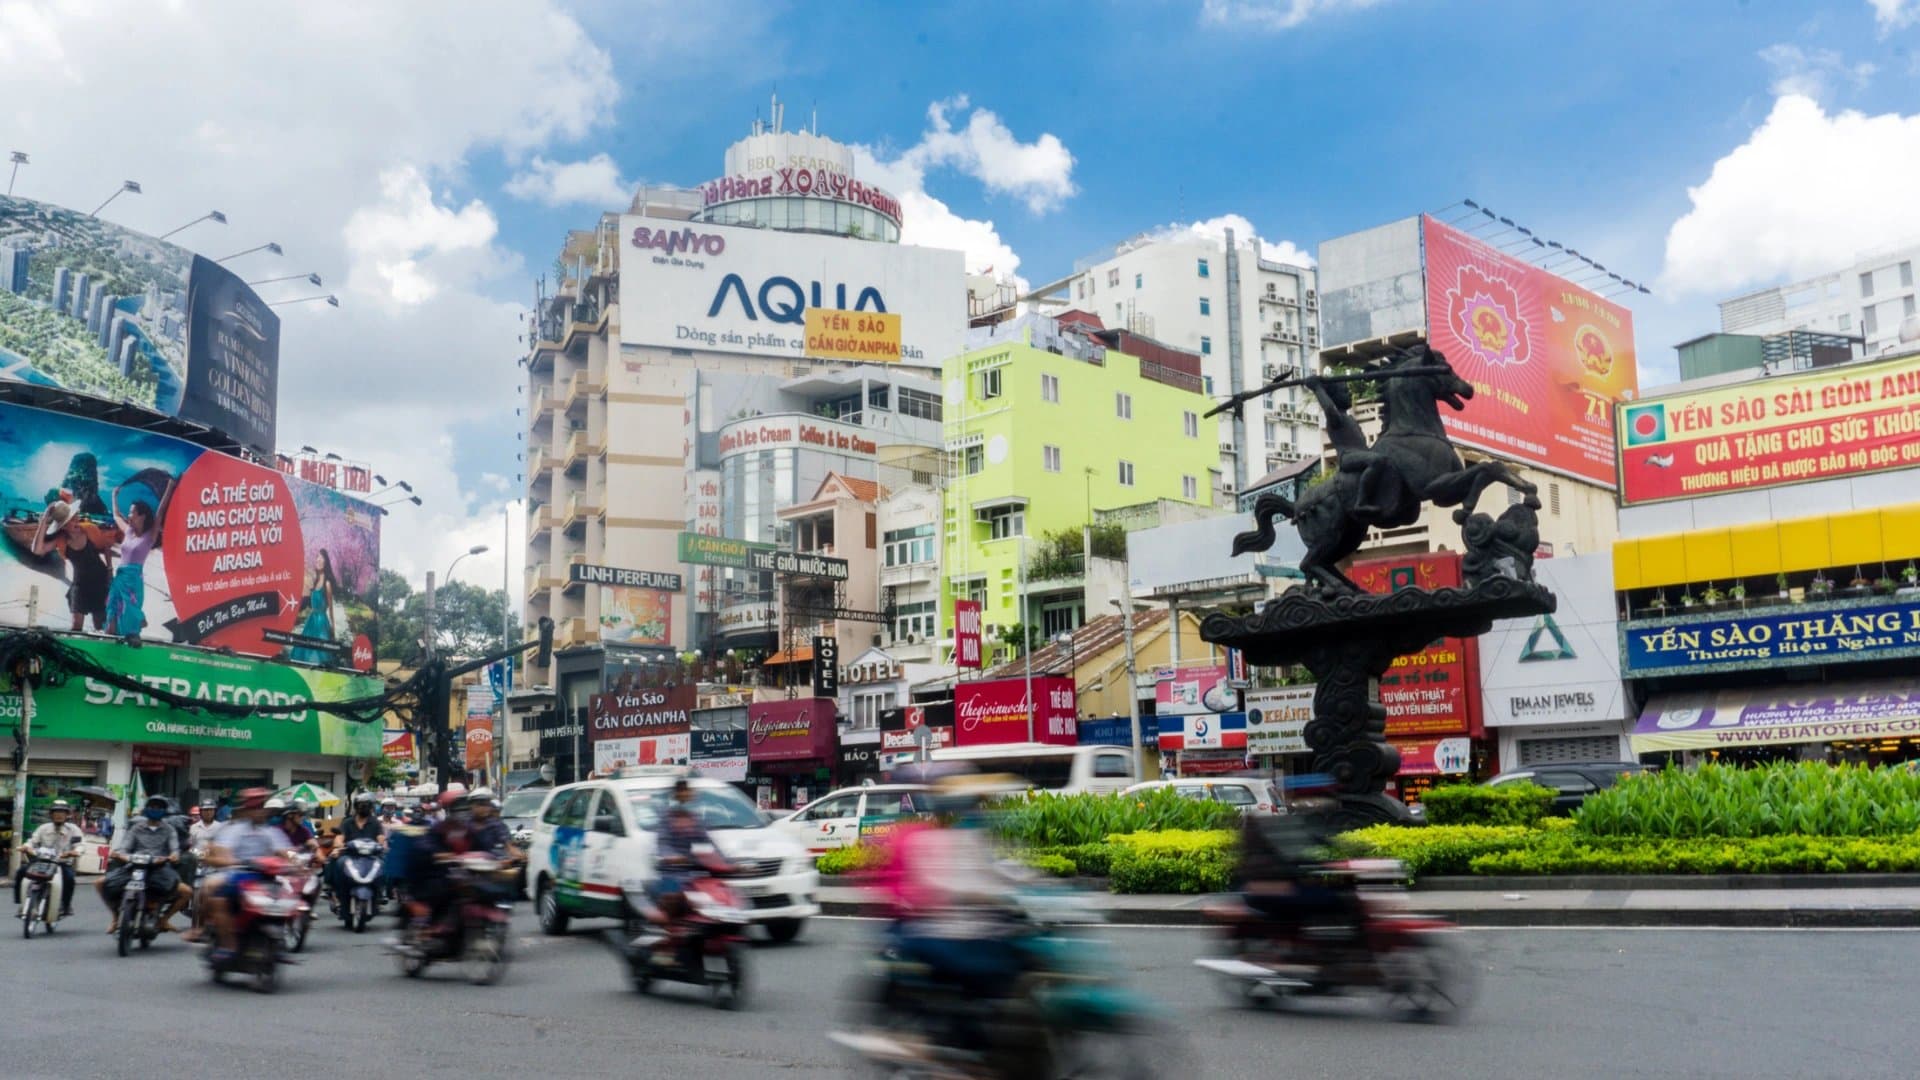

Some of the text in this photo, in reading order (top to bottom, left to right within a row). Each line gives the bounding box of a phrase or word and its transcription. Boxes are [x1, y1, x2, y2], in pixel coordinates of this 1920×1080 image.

[720, 173, 773, 202] Hàng
[777, 167, 848, 200] XOAY
[632, 227, 725, 256] SANYO
[707, 272, 888, 326] AQUA
[822, 314, 885, 333] YẾN SÀO
[676, 325, 717, 346] Dòng
[790, 338, 804, 349] ca
[858, 340, 899, 356] ANPHA
[1583, 394, 1607, 421] 71
[1670, 400, 1713, 433] YẾN
[1721, 396, 1766, 426] SÀO
[1774, 385, 1813, 416] SÀI
[1821, 377, 1872, 409] GÒN
[760, 426, 792, 443] Cream
[800, 424, 826, 446] Coffee
[1696, 436, 1731, 466] QUÀ
[1735, 432, 1782, 460] TẶNG
[1787, 426, 1825, 450] CHO
[1830, 416, 1868, 444] SỨC
[1681, 441, 1920, 491] THƯƠNG HIỆU ĐÃ ĐƯỢC BẢO HỘ ĐỘC QU
[201, 478, 274, 505] CẢ THẾ GIỚI
[187, 504, 283, 529] ĐANG CHỜ BẠN
[186, 524, 282, 552] KHÁM PHÁ VỚI
[213, 551, 263, 572] AIRASIA
[754, 551, 848, 578] THẾ GIỚI NƯỚC HOA
[580, 565, 677, 589] LINH PERFUME
[959, 606, 980, 634] NƯỚC
[1640, 612, 1902, 652] YẾN SÀO THĂNG
[963, 638, 979, 661] HOA
[1390, 656, 1408, 667] AO
[1431, 650, 1457, 664] YẾN
[1687, 647, 1771, 659] Thương
[1778, 641, 1828, 653] Hiệu
[1837, 635, 1893, 650] Ngàn
[821, 638, 833, 689] HOTEL
[838, 661, 900, 683] HOTEL
[616, 692, 664, 708] Yến Sào
[959, 688, 1039, 731] Thegioinuocha
[1554, 692, 1595, 710] JEWELS
[595, 709, 687, 730] CẦN GIỜ ANPHA
[1716, 720, 1920, 742] WWW.BIATOYEN.CO
